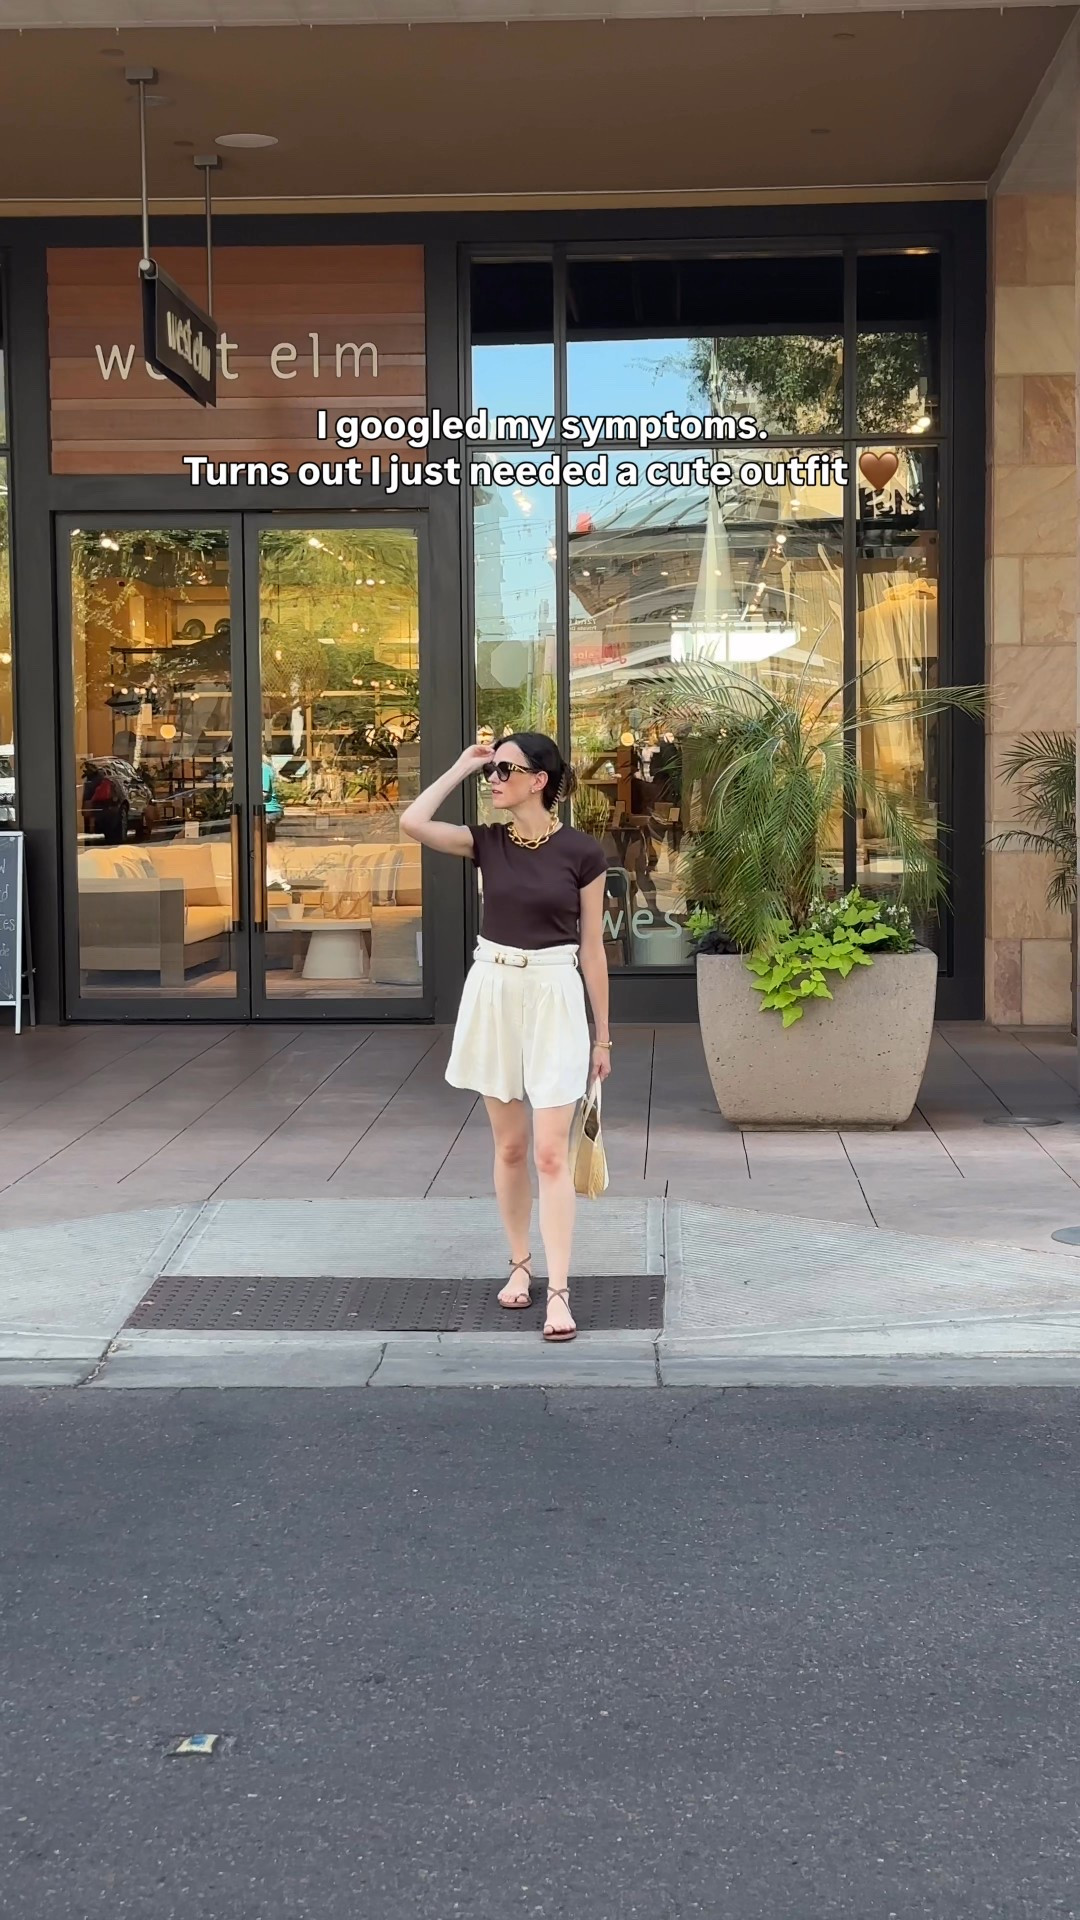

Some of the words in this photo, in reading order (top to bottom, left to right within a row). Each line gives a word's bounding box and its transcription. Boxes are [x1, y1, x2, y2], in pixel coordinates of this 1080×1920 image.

[95, 333, 239, 381] wt
[270, 332, 379, 379] elm
[166, 310, 193, 365] west
[192, 331, 211, 382] elm
[602, 909, 683, 940] wes
